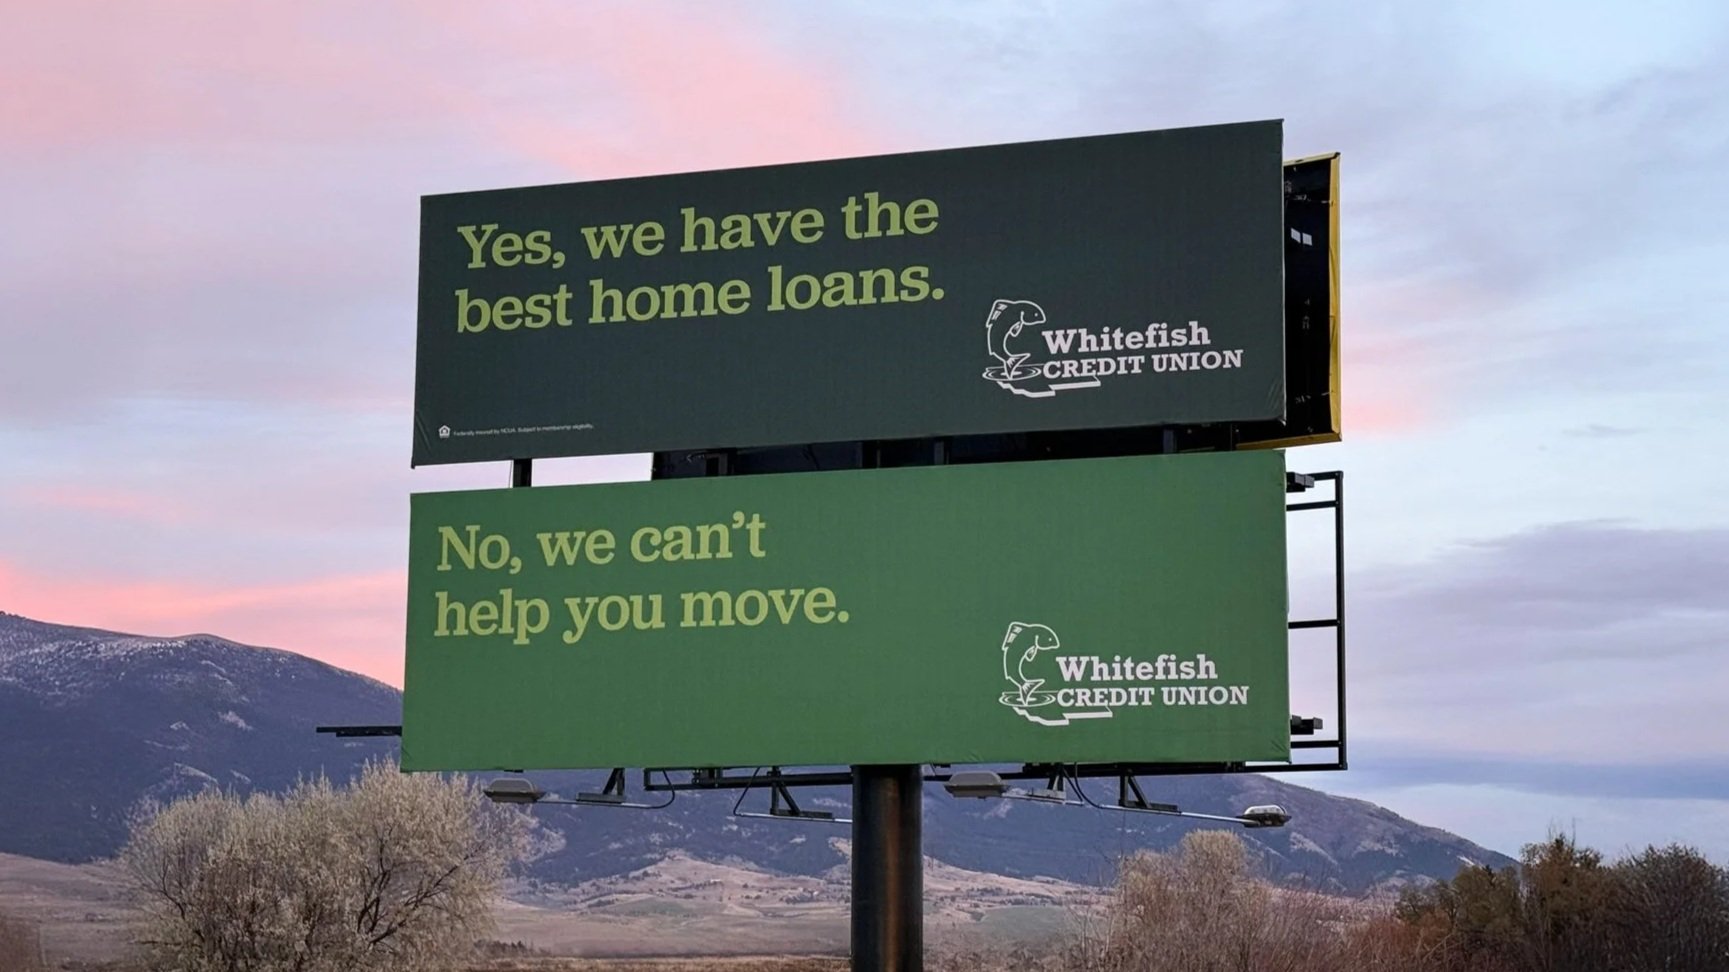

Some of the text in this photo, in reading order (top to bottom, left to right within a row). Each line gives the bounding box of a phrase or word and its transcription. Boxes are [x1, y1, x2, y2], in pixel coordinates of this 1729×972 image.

[458, 192, 938, 270] Yes, we have the
[456, 266, 944, 332] best home loans.
[1042, 321, 1210, 355] Whitefish
[1043, 350, 1243, 379] CREDIT UNION
[438, 526, 521, 574] No,
[537, 530, 615, 565] we
[435, 588, 848, 645] help you move.
[1056, 655, 1217, 681] Whitefish
[1058, 686, 1249, 707] CREDIT UNION
